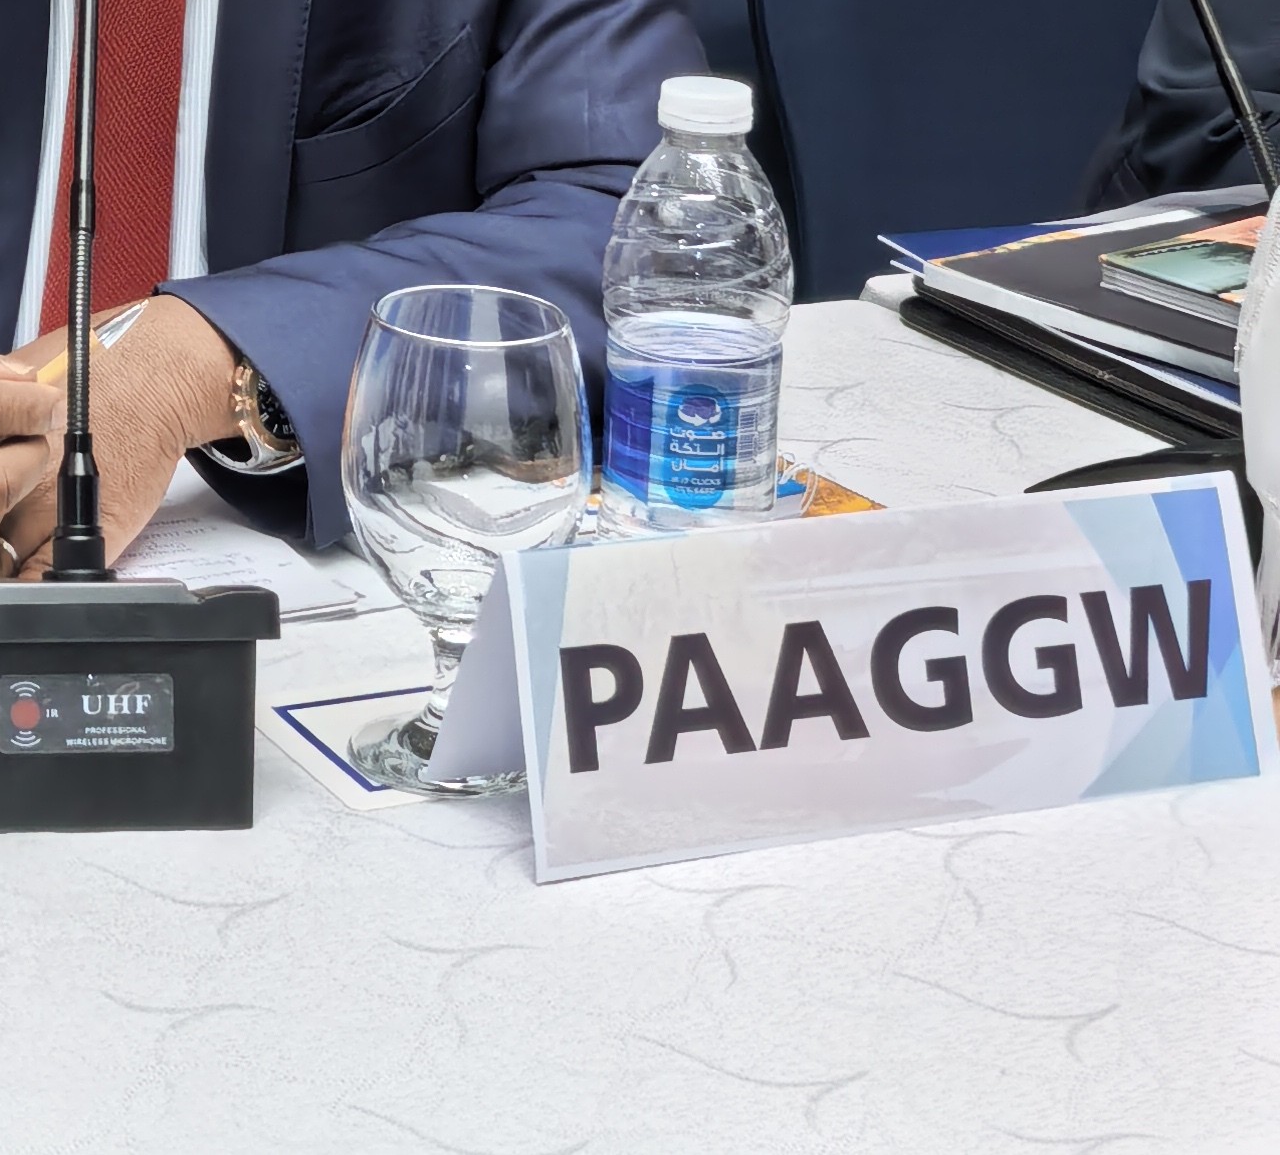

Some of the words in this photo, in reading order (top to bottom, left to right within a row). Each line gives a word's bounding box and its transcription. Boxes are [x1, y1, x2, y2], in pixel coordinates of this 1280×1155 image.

[669, 426, 727, 441] صوت
[669, 439, 726, 455] التكة
[558, 579, 1213, 774] PAAGGW
[81, 694, 152, 715] UHF
[84, 726, 147, 735] PROFESSIONAL
[65, 737, 109, 747] WIRELESS
[110, 736, 168, 746] MICROPHONE
